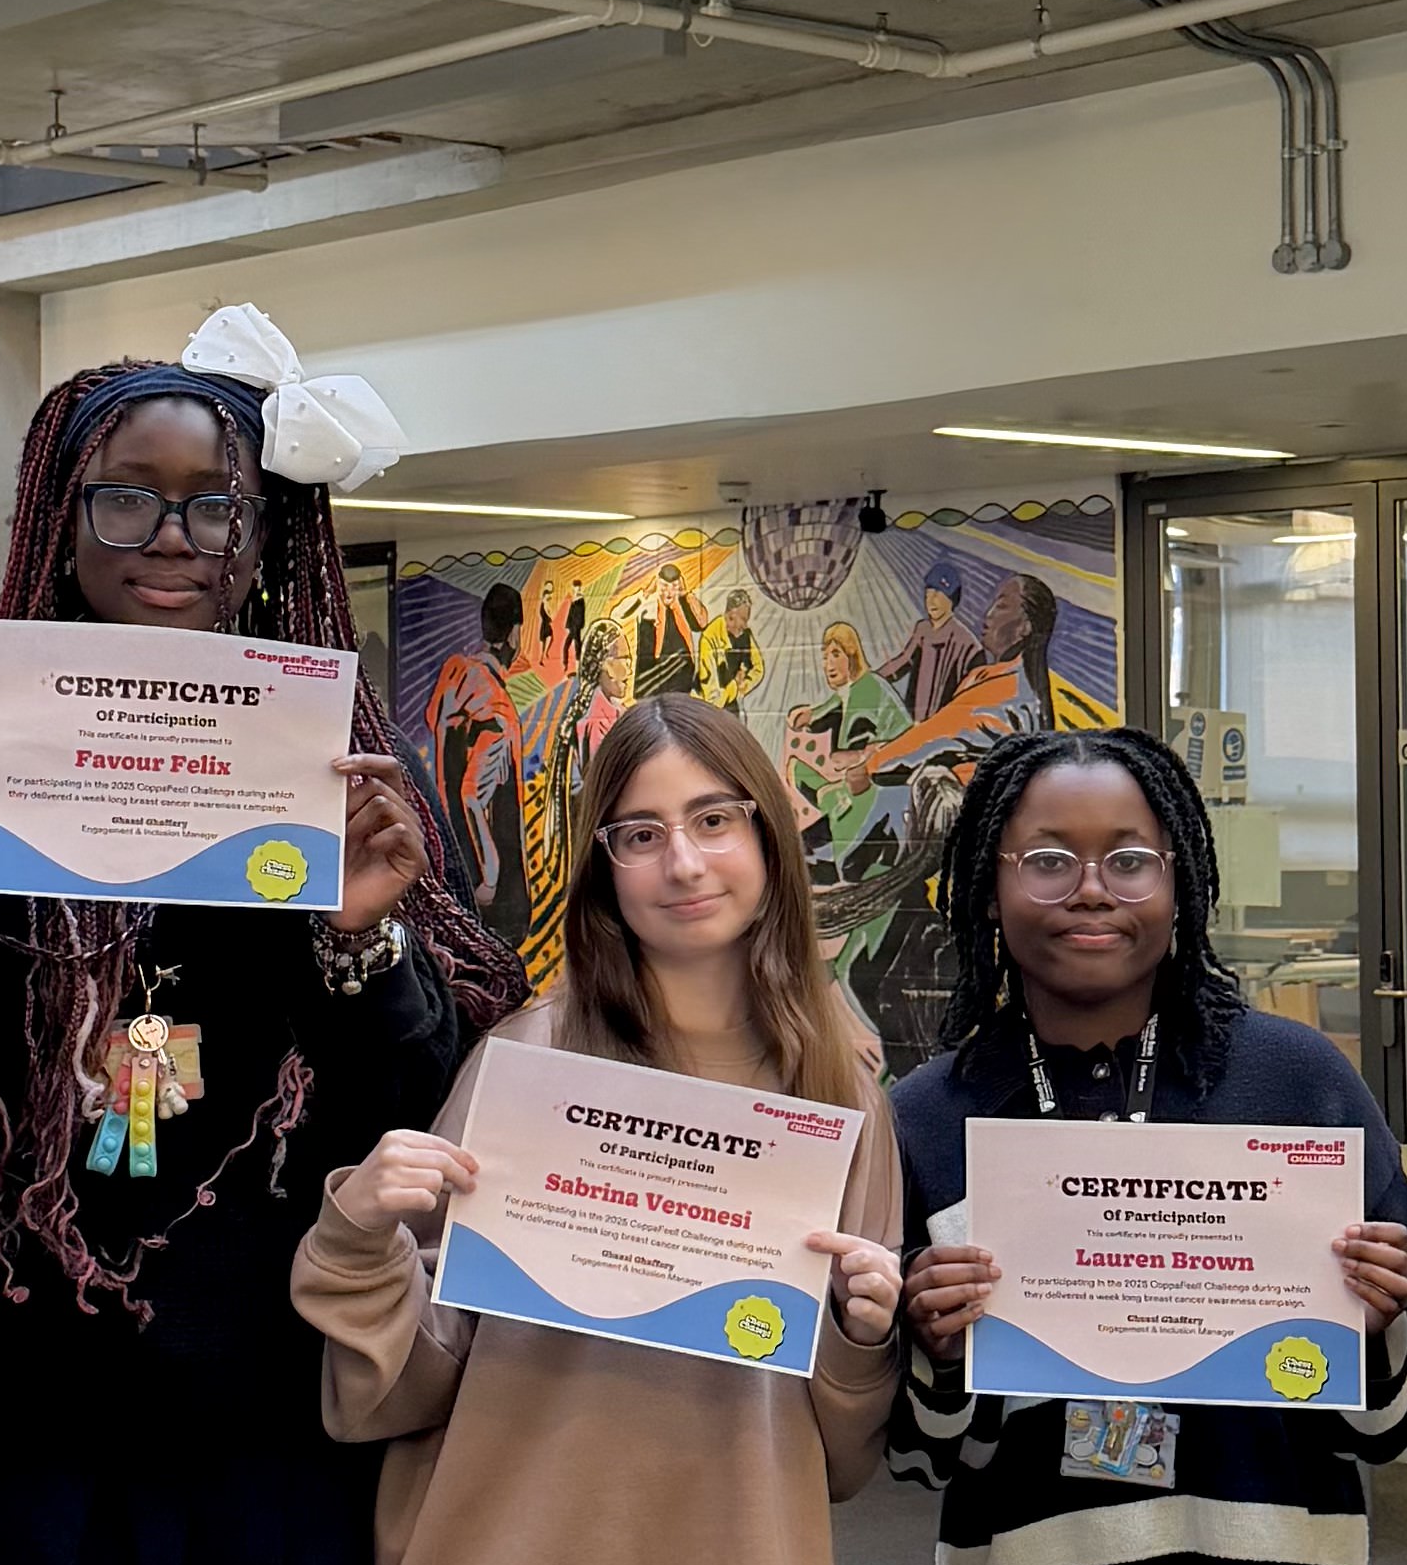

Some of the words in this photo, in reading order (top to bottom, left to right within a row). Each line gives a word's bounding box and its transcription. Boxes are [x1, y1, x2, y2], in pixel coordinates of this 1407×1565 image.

[243, 649, 340, 668] CoppaFeel!
[55, 675, 260, 706] CERTIFICATE
[96, 709, 114, 721] Of
[117, 711, 216, 727] Participation
[74, 750, 165, 772] Favour
[169, 754, 231, 775] Felix
[753, 1102, 845, 1129] CoppaFeel!
[566, 1104, 762, 1159] CERTIFICATE
[1247, 1138, 1345, 1153] CoppaFeel!
[599, 1142, 618, 1154] Of
[619, 1146, 714, 1174] Participation
[1061, 1177, 1267, 1201] CERTIFICATE
[545, 1173, 638, 1207] Sabrina
[645, 1192, 752, 1230] Veronesi
[1103, 1209, 1121, 1221] Of
[1124, 1210, 1225, 1225] Participation
[1076, 1248, 1165, 1268] Lauren
[1171, 1251, 1254, 1271] Brown
